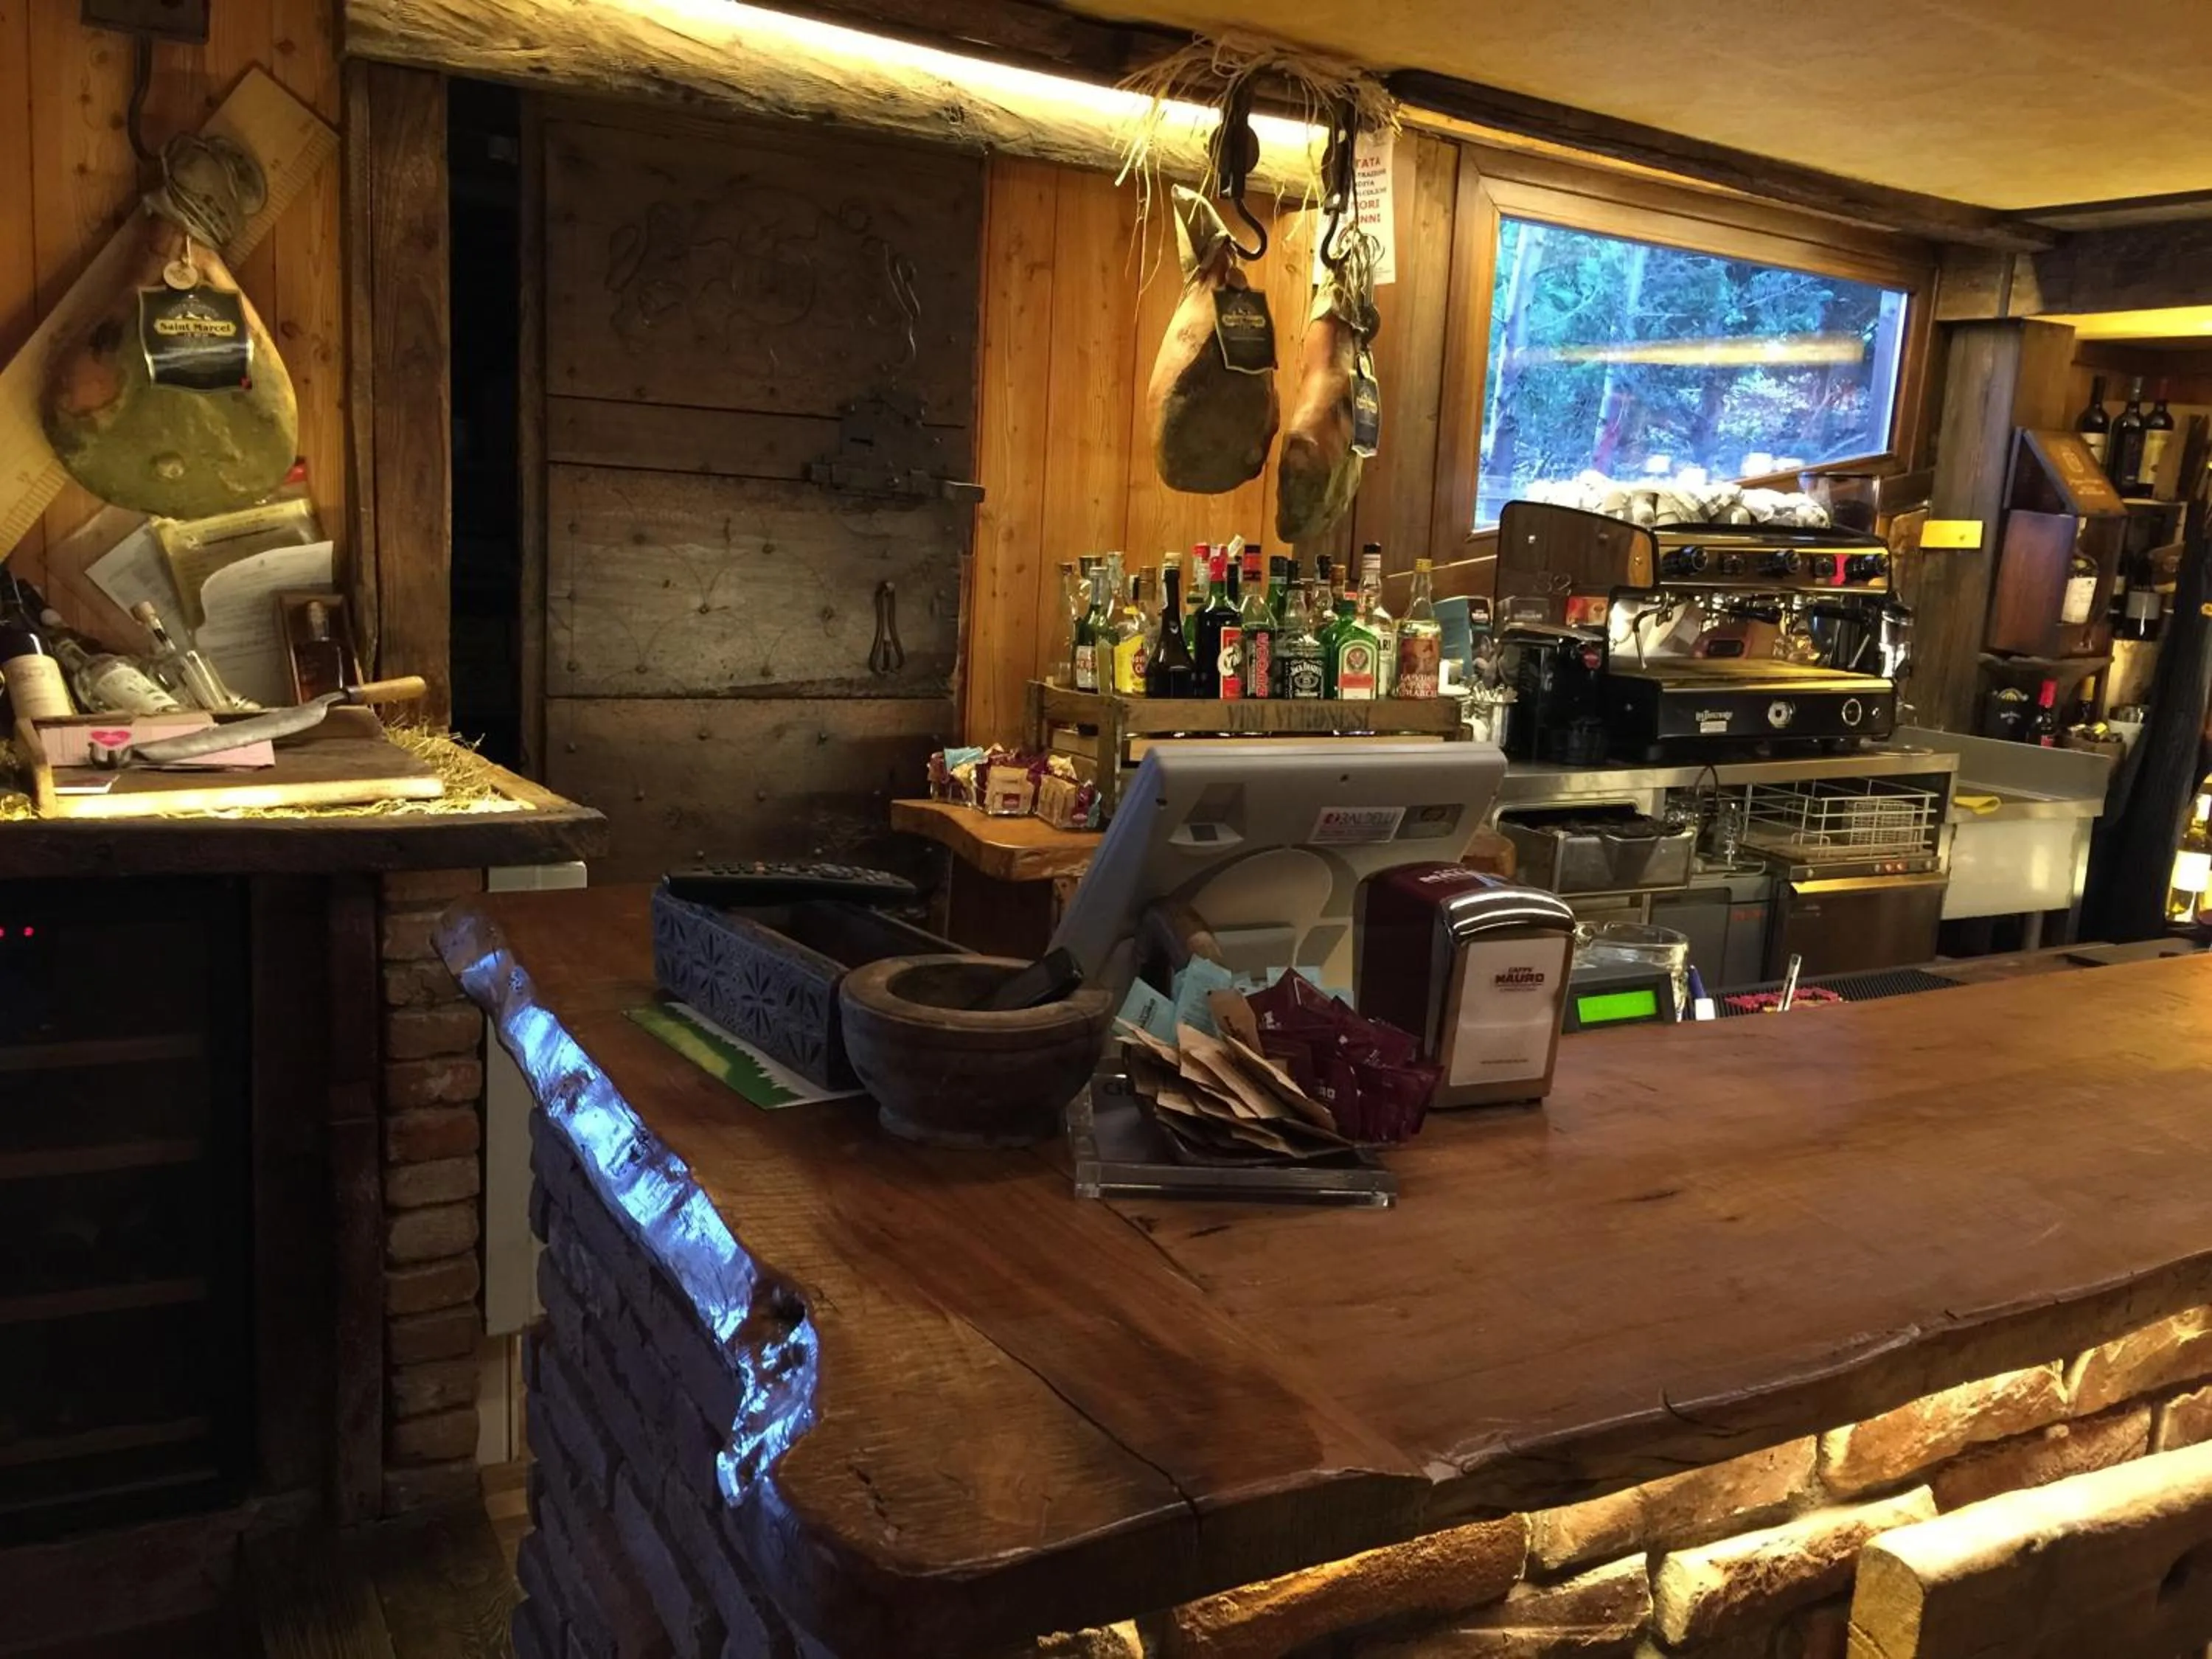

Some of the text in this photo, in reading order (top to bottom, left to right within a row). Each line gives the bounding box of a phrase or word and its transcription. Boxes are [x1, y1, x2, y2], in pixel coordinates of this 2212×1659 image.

[1355, 156, 1380, 169] TATA
[159, 321, 232, 333] Saint Marcel
[1377, 639, 1391, 650] ARI
[1495, 973, 1545, 984] MAURO
